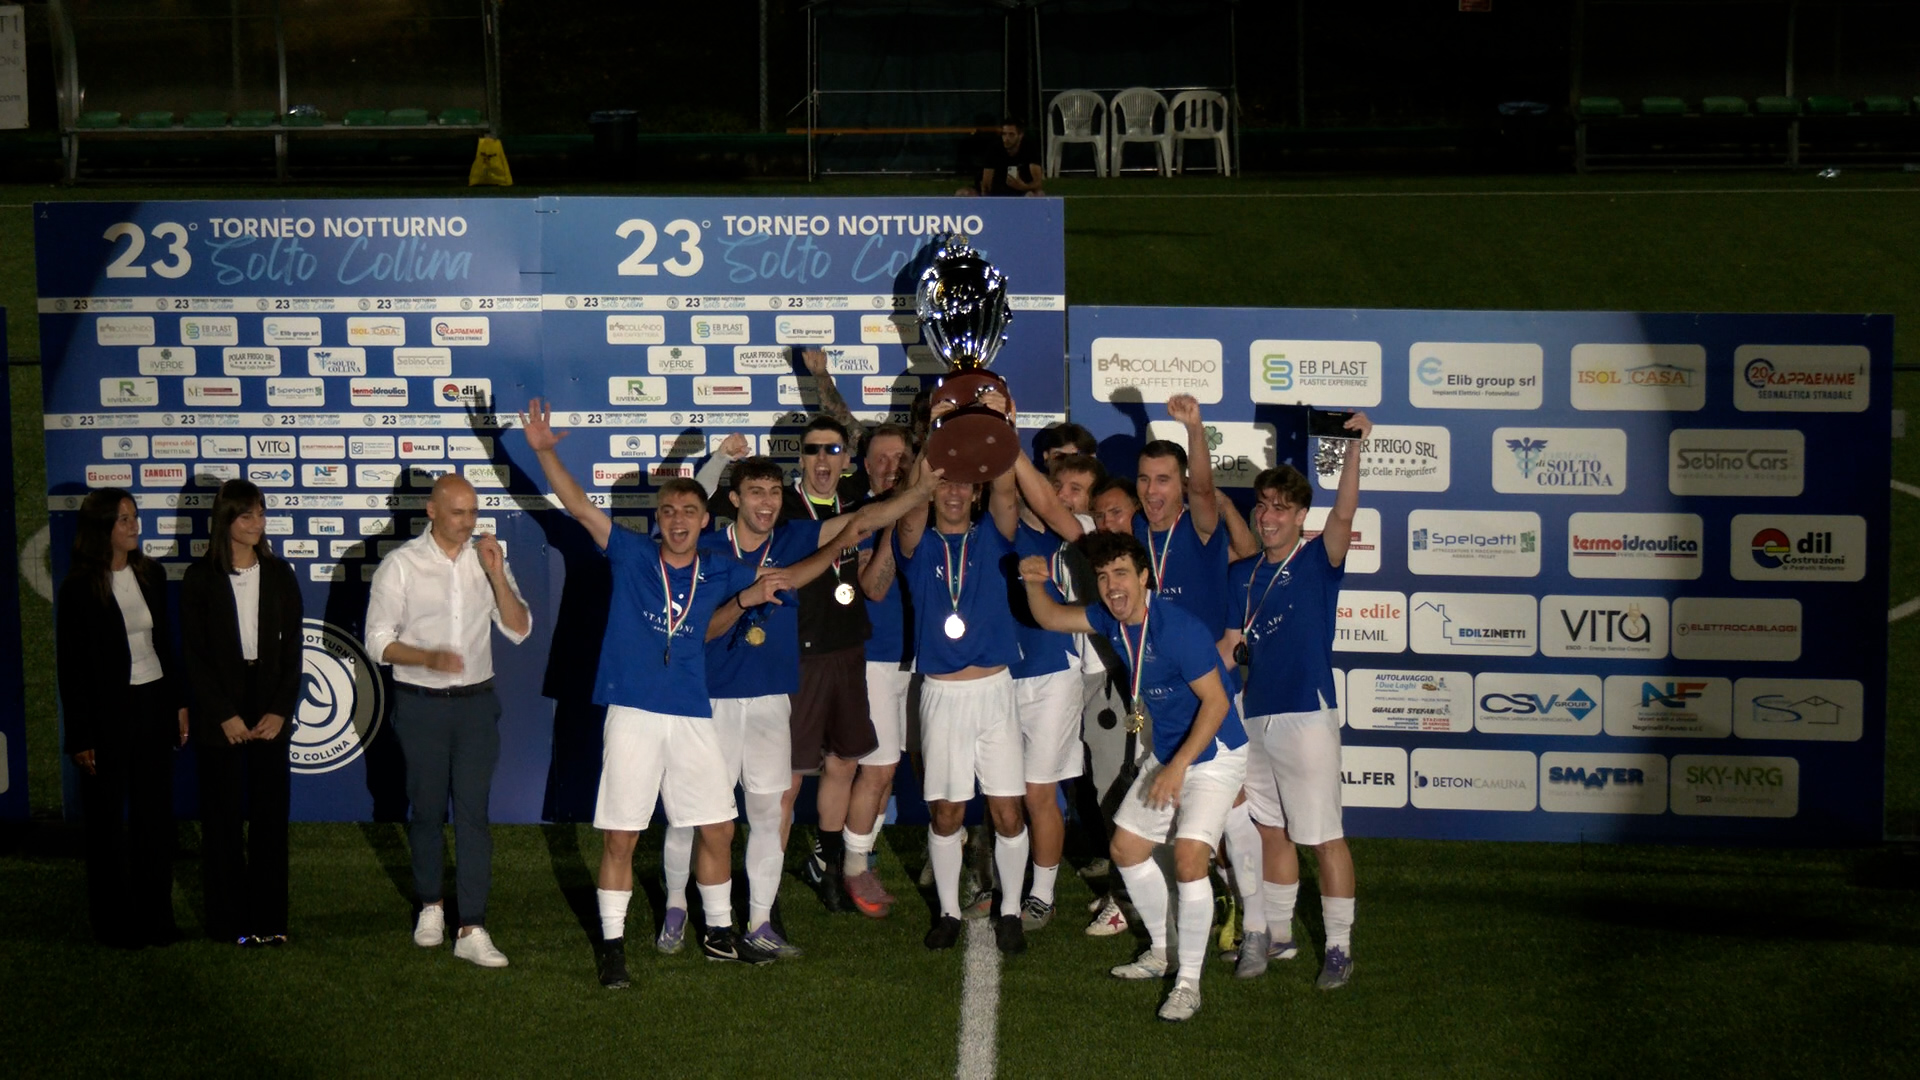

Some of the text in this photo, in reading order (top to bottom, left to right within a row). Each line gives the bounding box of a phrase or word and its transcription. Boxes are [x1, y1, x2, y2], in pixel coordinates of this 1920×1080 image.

[209, 216, 468, 238] TORNEO NOTTURNO
[723, 215, 983, 236] TORNEO NOTTURNO
[205, 235, 472, 286] Solto Collina
[718, 233, 831, 284] Solto
[74, 300, 88, 310] 23
[175, 300, 189, 309] 23
[276, 300, 290, 309] 23
[377, 300, 392, 309] 23
[479, 299, 494, 309] 23
[584, 298, 598, 307] 23
[686, 298, 700, 307] 23
[788, 298, 802, 307] 23
[892, 298, 906, 307] 23
[229, 353, 246, 362] POLAR
[740, 351, 775, 360] POLAR FRIGO
[1097, 353, 1216, 373] BARCOLLANDO
[1299, 360, 1368, 376] EB PLAST
[1105, 376, 1209, 388] BAR CAFFETTERIA
[1299, 378, 1368, 387] PLASTIC EXPERIENCE
[1447, 374, 1536, 389] Elib group srl
[1577, 370, 1686, 385] ISOL CASA
[1766, 372, 1855, 385] KAPPAEMME
[1432, 389, 1457, 397] Impianti
[1458, 389, 1480, 397] Elettrici
[1758, 389, 1852, 400] SEGNALETICA STRADALE
[80, 416, 94, 425] 23
[181, 416, 196, 424] 23
[281, 416, 296, 425] 23
[382, 416, 396, 425] 23
[483, 416, 497, 425] 23
[588, 414, 602, 424] 23
[690, 414, 704, 424] 23
[792, 414, 806, 424] 23
[894, 414, 908, 424] 23
[1373, 438, 1412, 455] FRIGO
[1415, 441, 1438, 460] SRL
[1677, 448, 1788, 470] Sebino Cars
[1547, 459, 1602, 473] SOLTO
[144, 469, 183, 477] ZANOLETTI
[250, 471, 278, 479] CSV
[1372, 466, 1393, 477] Celle
[1395, 466, 1437, 478] Frigorifere
[1536, 472, 1613, 487] COLLINA
[185, 496, 199, 506] 23
[285, 496, 299, 506] 23
[386, 496, 400, 506] 23
[486, 497, 500, 506] 23
[592, 496, 604, 504] 23
[1432, 532, 1516, 547] Spelgatti
[1573, 534, 1698, 551] termoidraulica
[1783, 554, 1845, 565] Costruzioni
[1360, 603, 1401, 619] edile
[1690, 623, 1797, 633] ELETTROCABLAGGI
[1354, 629, 1389, 641] EMIL
[1458, 628, 1526, 639] EDILZINETTI
[303, 634, 357, 665] OTTURNO
[1375, 674, 1434, 682] AUTOLAVAGGIO
[1395, 682, 1416, 690] Laghi
[1641, 681, 1709, 708] NF
[1480, 693, 1559, 714] CSV
[303, 740, 351, 762] COLLINA
[1340, 771, 1395, 786] AL.FER
[1548, 766, 1644, 789] SMATER
[1686, 765, 1783, 787] SKY-NRG
